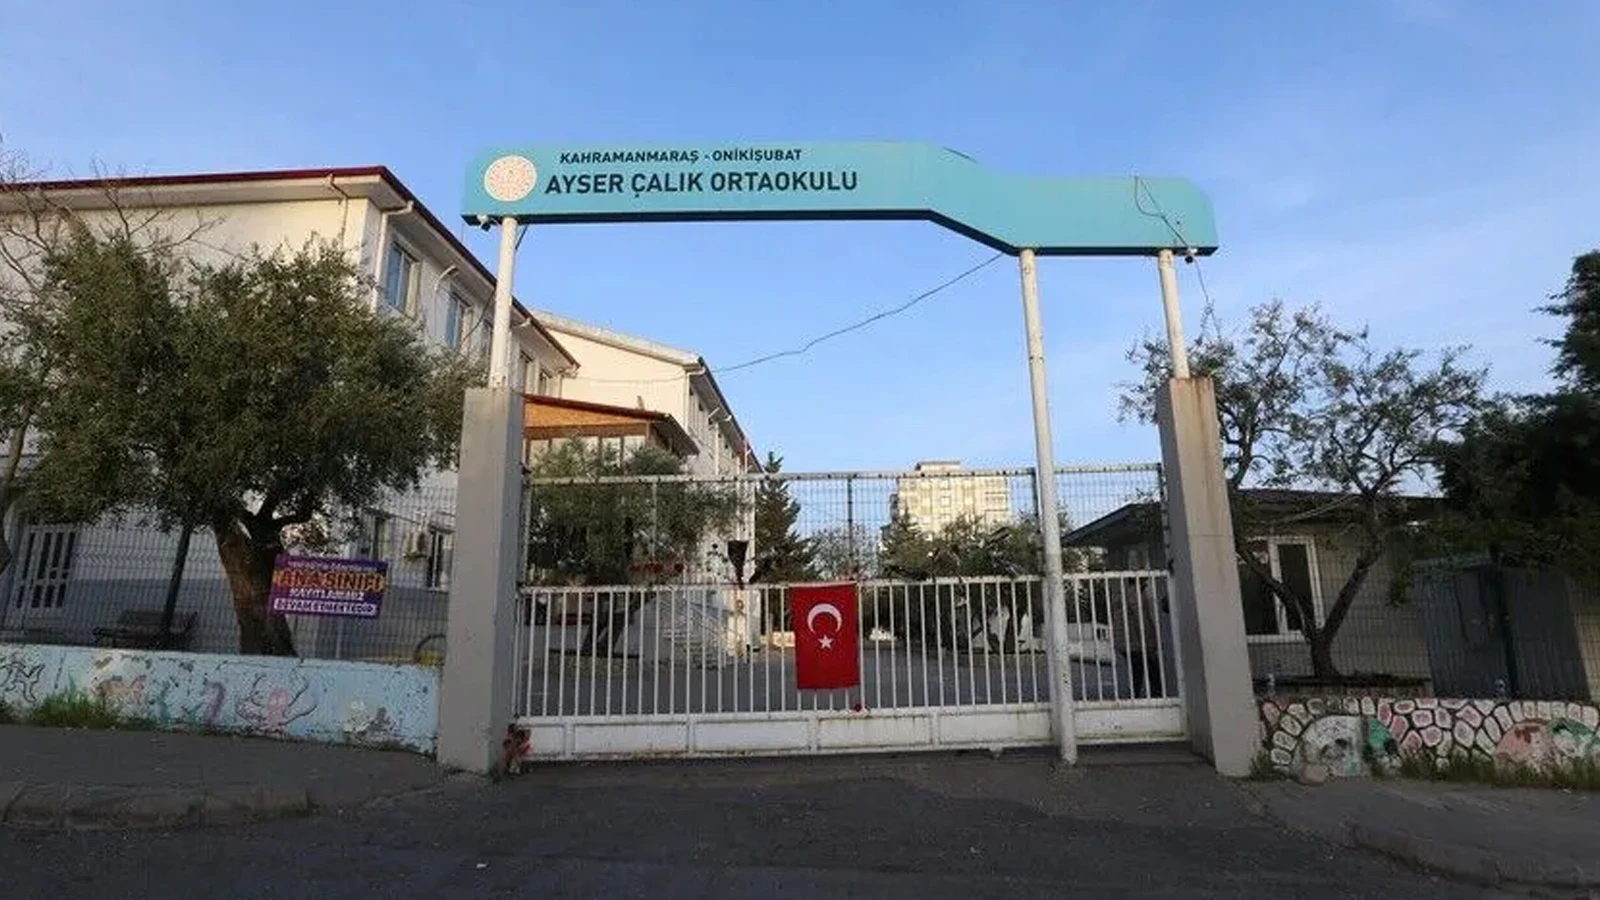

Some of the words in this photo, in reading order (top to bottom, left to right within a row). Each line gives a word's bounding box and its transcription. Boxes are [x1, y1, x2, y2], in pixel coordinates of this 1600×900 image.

[560, 150, 699, 164] KAHRAMANMARAŞ
[712, 148, 802, 163] ONİKİŞUBAT
[545, 173, 624, 194] AYSER
[631, 172, 703, 198] ÇALIK
[710, 171, 857, 192] ORTAOKULU
